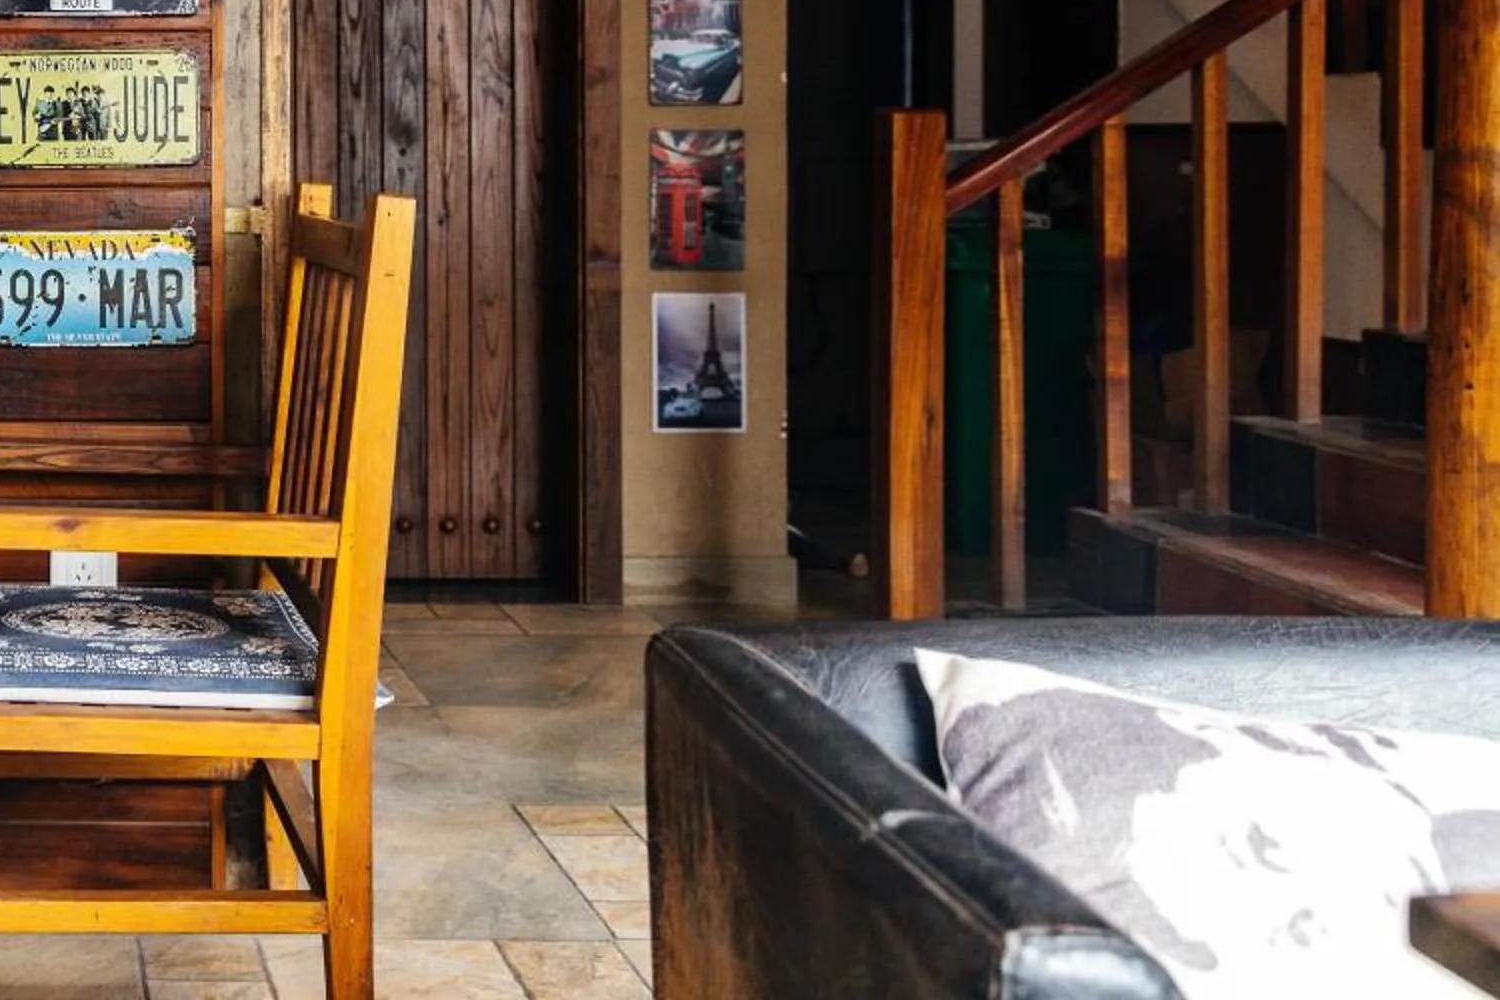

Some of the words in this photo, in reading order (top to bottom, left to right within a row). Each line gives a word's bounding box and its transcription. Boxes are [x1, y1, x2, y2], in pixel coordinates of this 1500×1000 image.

[29, 57, 96, 72] NORWEGIAN
[113, 75, 190, 143] JUDE
[52, 147, 69, 158] THE
[73, 147, 114, 159] BEATLES
[30, 239, 136, 261] NEVADA
